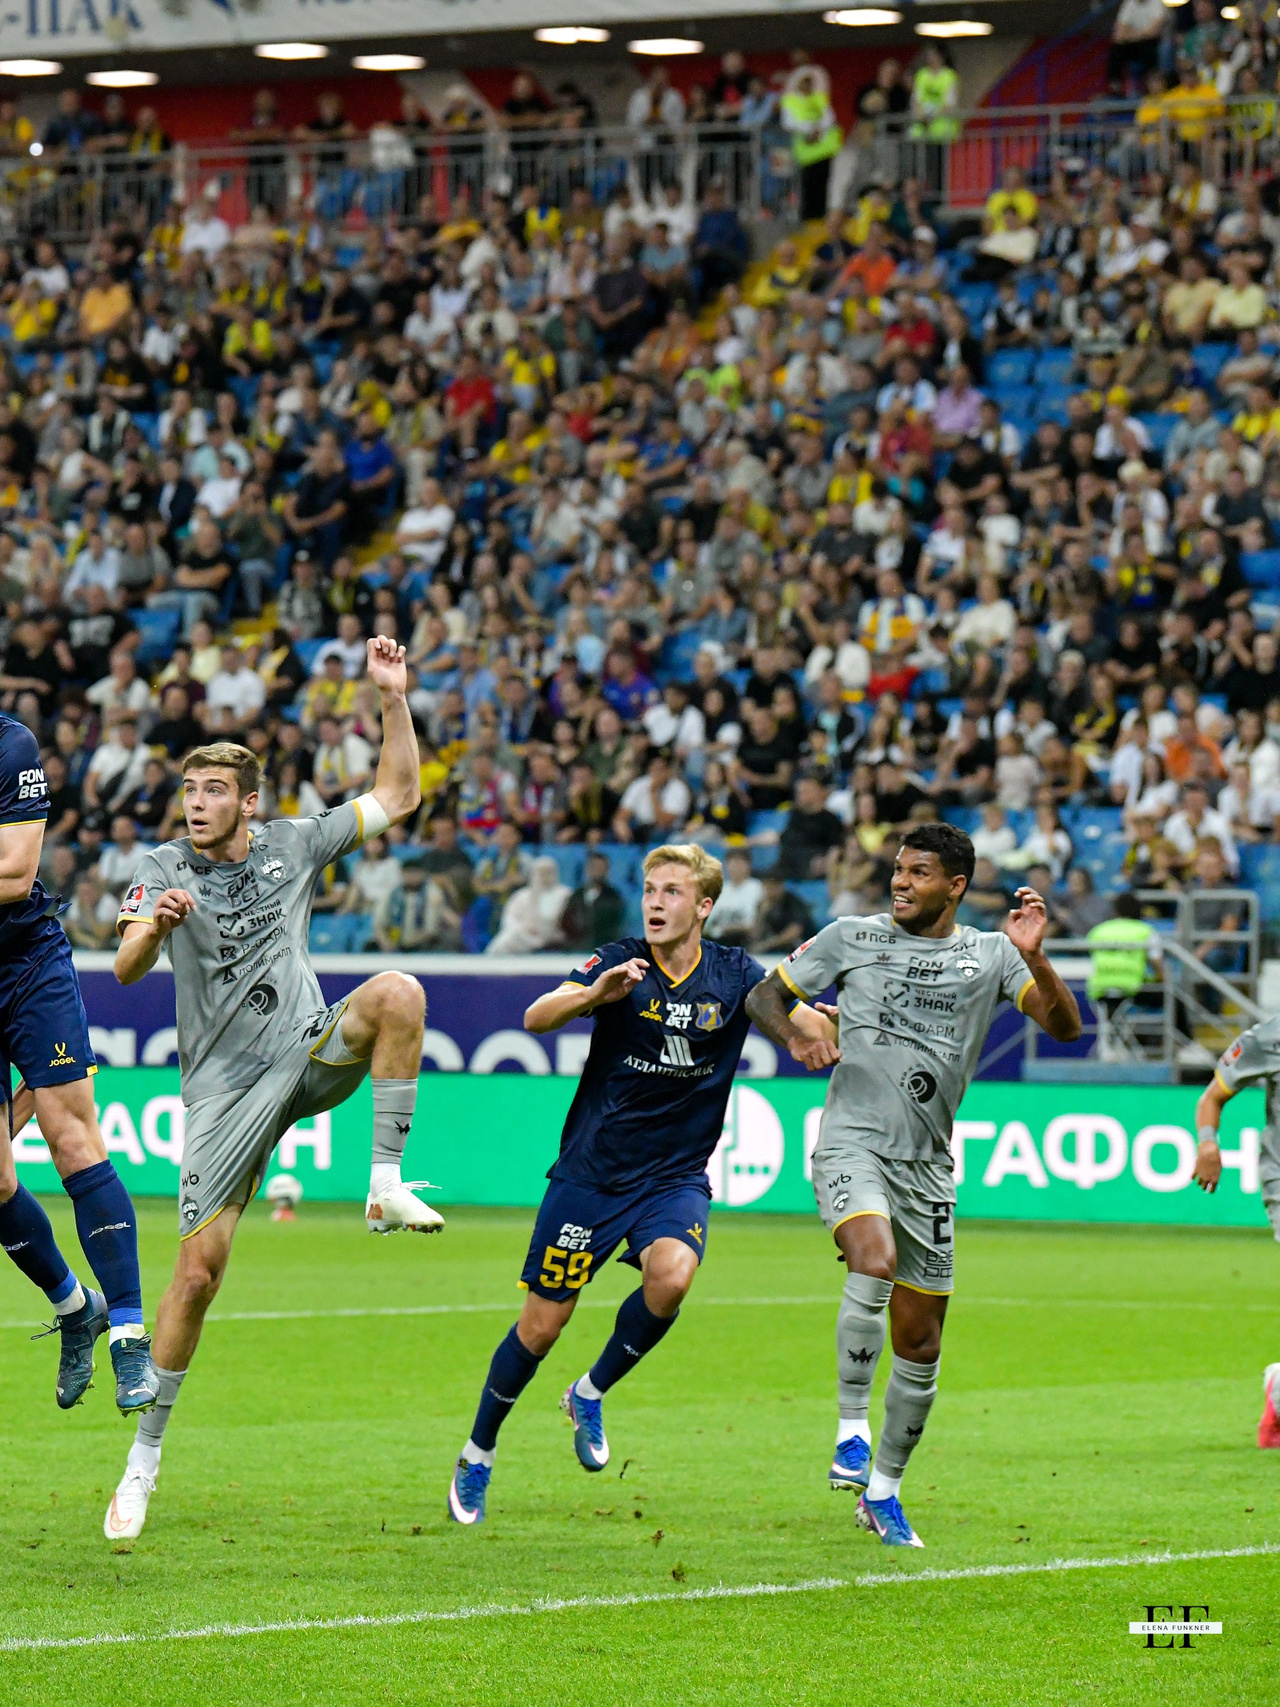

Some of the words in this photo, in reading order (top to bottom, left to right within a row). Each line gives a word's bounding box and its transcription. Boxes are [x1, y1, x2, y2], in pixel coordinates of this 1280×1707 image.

[19, 768, 45, 785] FON
[18, 782, 48, 800] BET
[244, 898, 282, 917] ЧЕСТНЫЙ
[247, 908, 287, 929] ЗНАК
[869, 932, 897, 945] ПСБ
[906, 966, 943, 982] BET
[915, 988, 957, 1000] ЧЕСТНЫЙ
[914, 997, 956, 1013] ЗНАК
[665, 1015, 693, 1030] BET
[828, 1173, 852, 1189] wb
[559, 1223, 593, 1239] FON
[932, 1203, 952, 1245] 2
[556, 1234, 591, 1250] BET
[539, 1245, 593, 1289] 59
